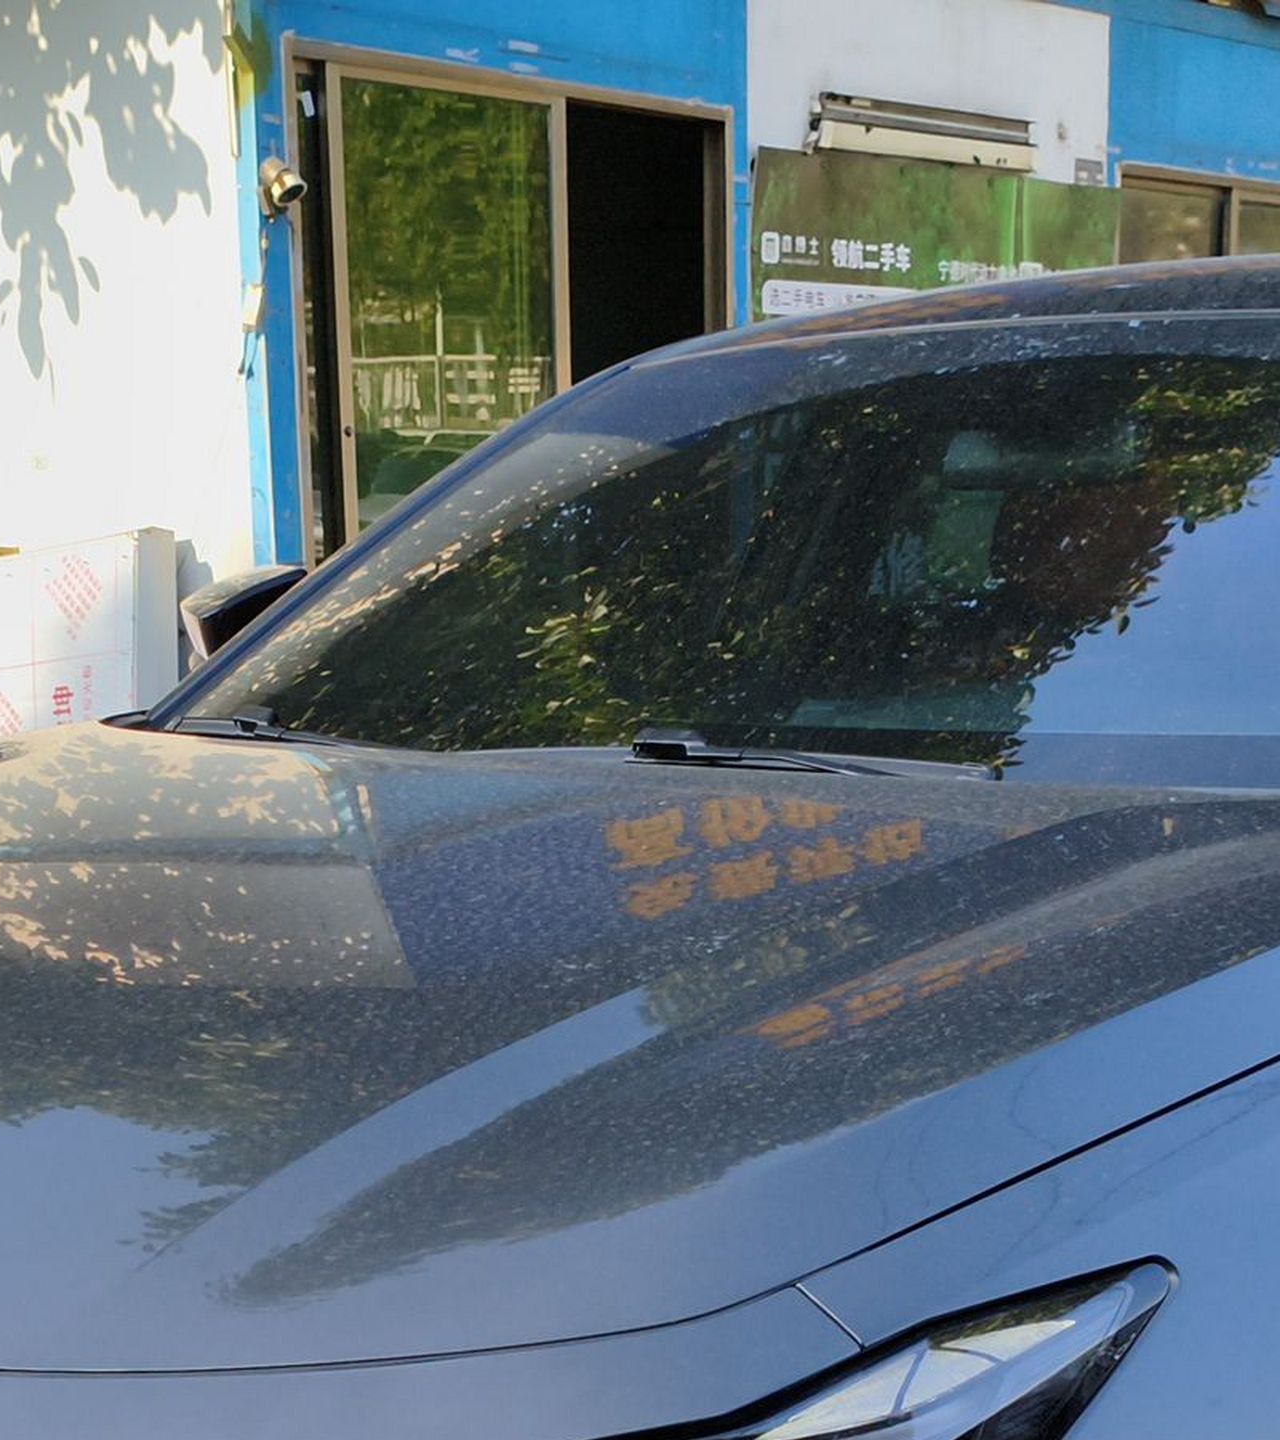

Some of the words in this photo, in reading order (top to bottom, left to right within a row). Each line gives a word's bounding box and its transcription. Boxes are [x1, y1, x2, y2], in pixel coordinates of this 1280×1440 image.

[830, 238, 912, 273] 领航二手车
